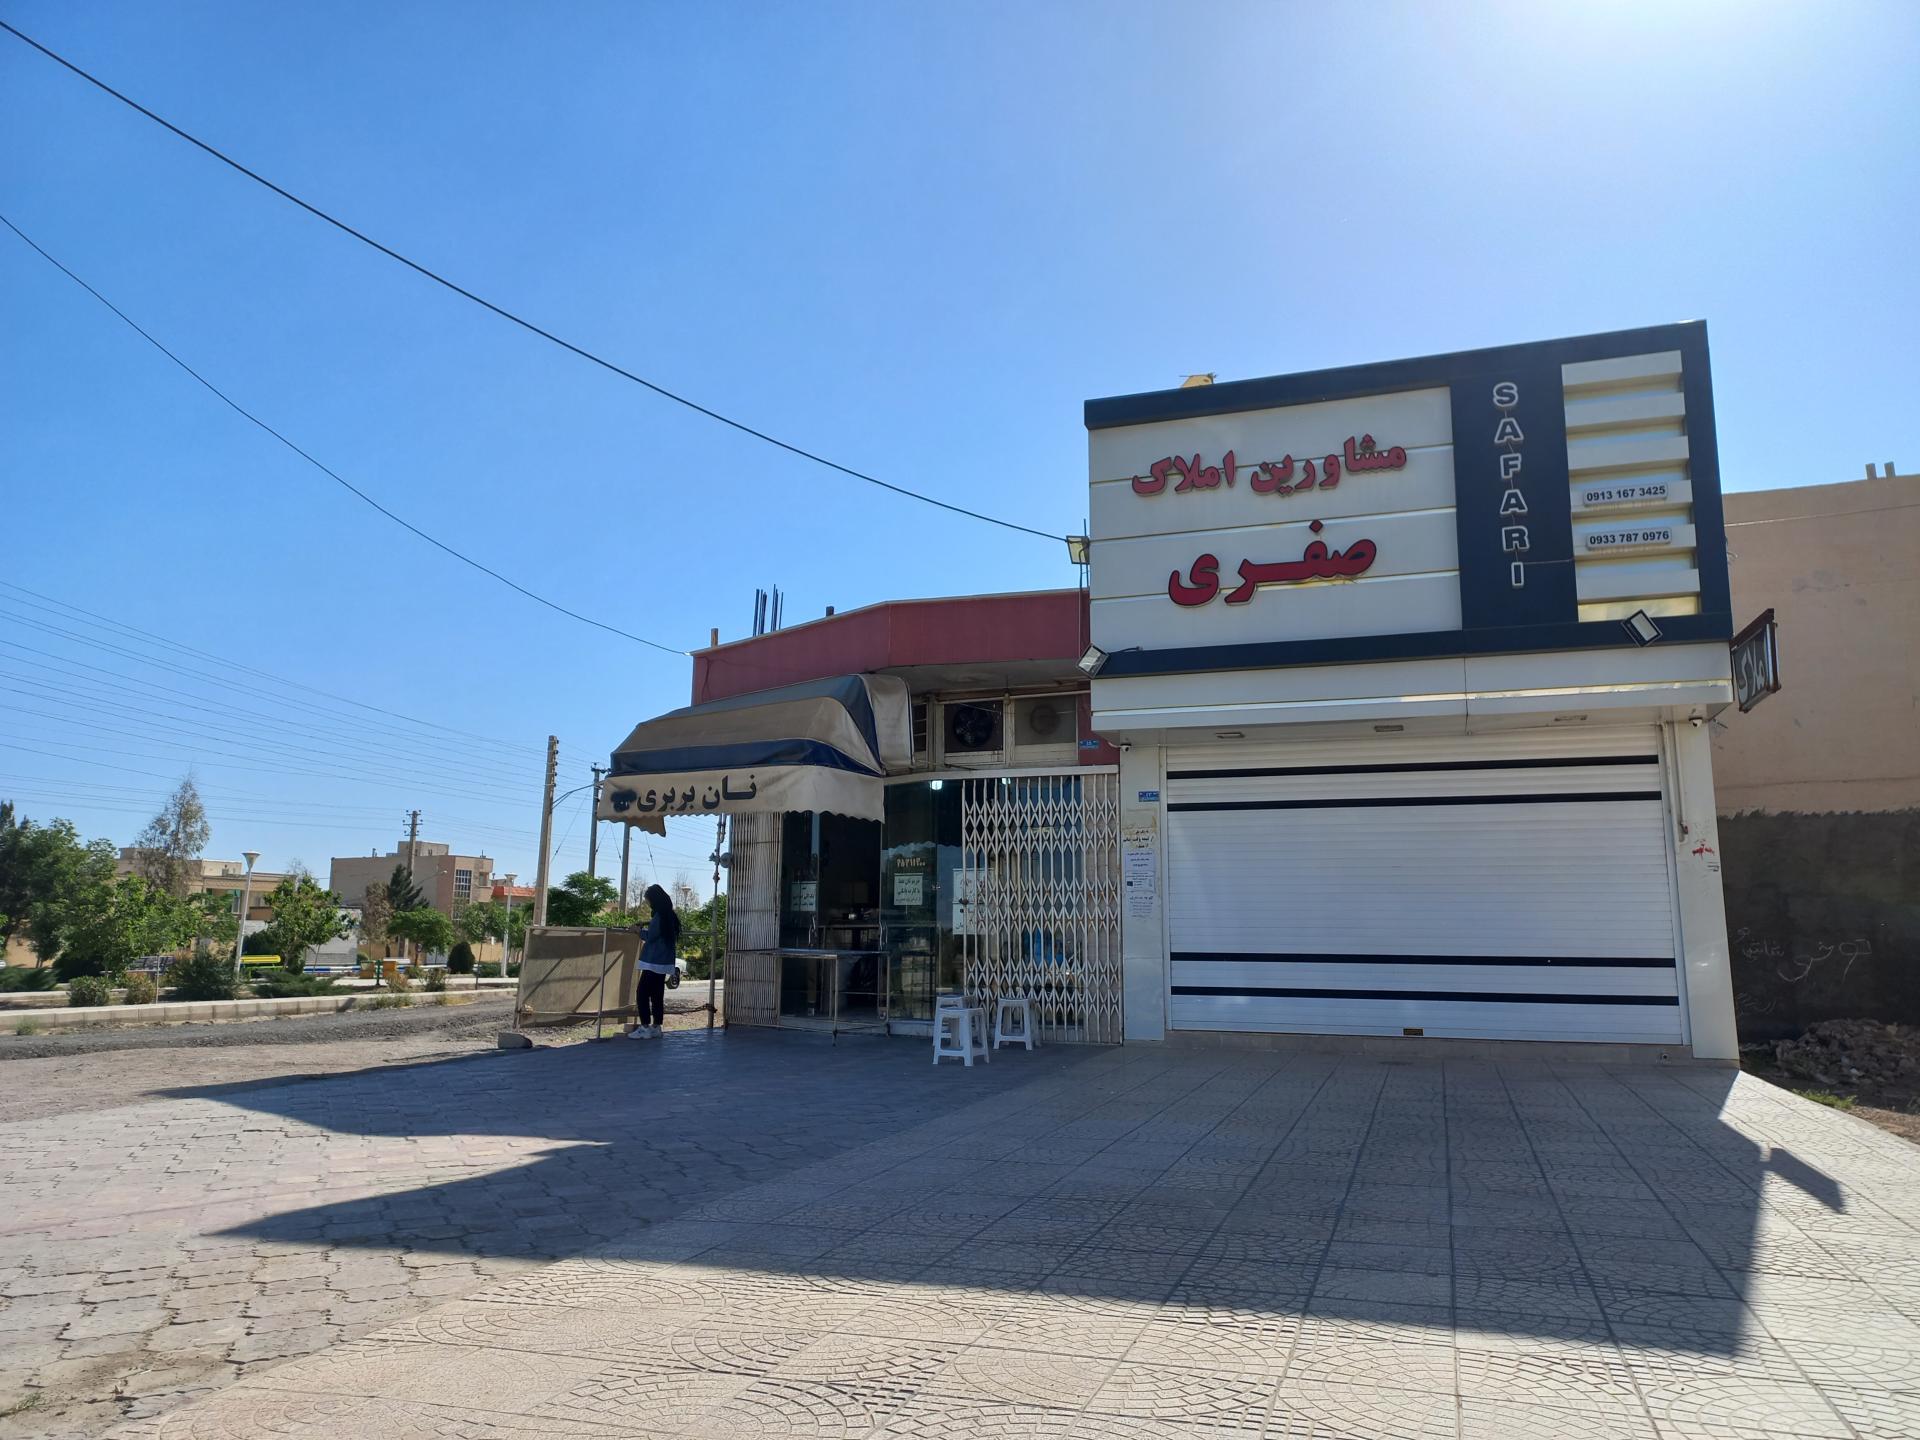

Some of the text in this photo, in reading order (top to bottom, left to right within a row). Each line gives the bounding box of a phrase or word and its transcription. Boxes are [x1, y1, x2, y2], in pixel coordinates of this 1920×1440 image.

[1132, 434, 1406, 497] مشاورین املاک
[1493, 382, 1530, 587] SAFARI
[1587, 486, 1666, 501] 0913 167 3425
[1590, 531, 1669, 545] 0933 787 0976
[1168, 519, 1378, 607] صفری
[637, 785, 696, 812] بربری
[702, 774, 757, 810] نان
